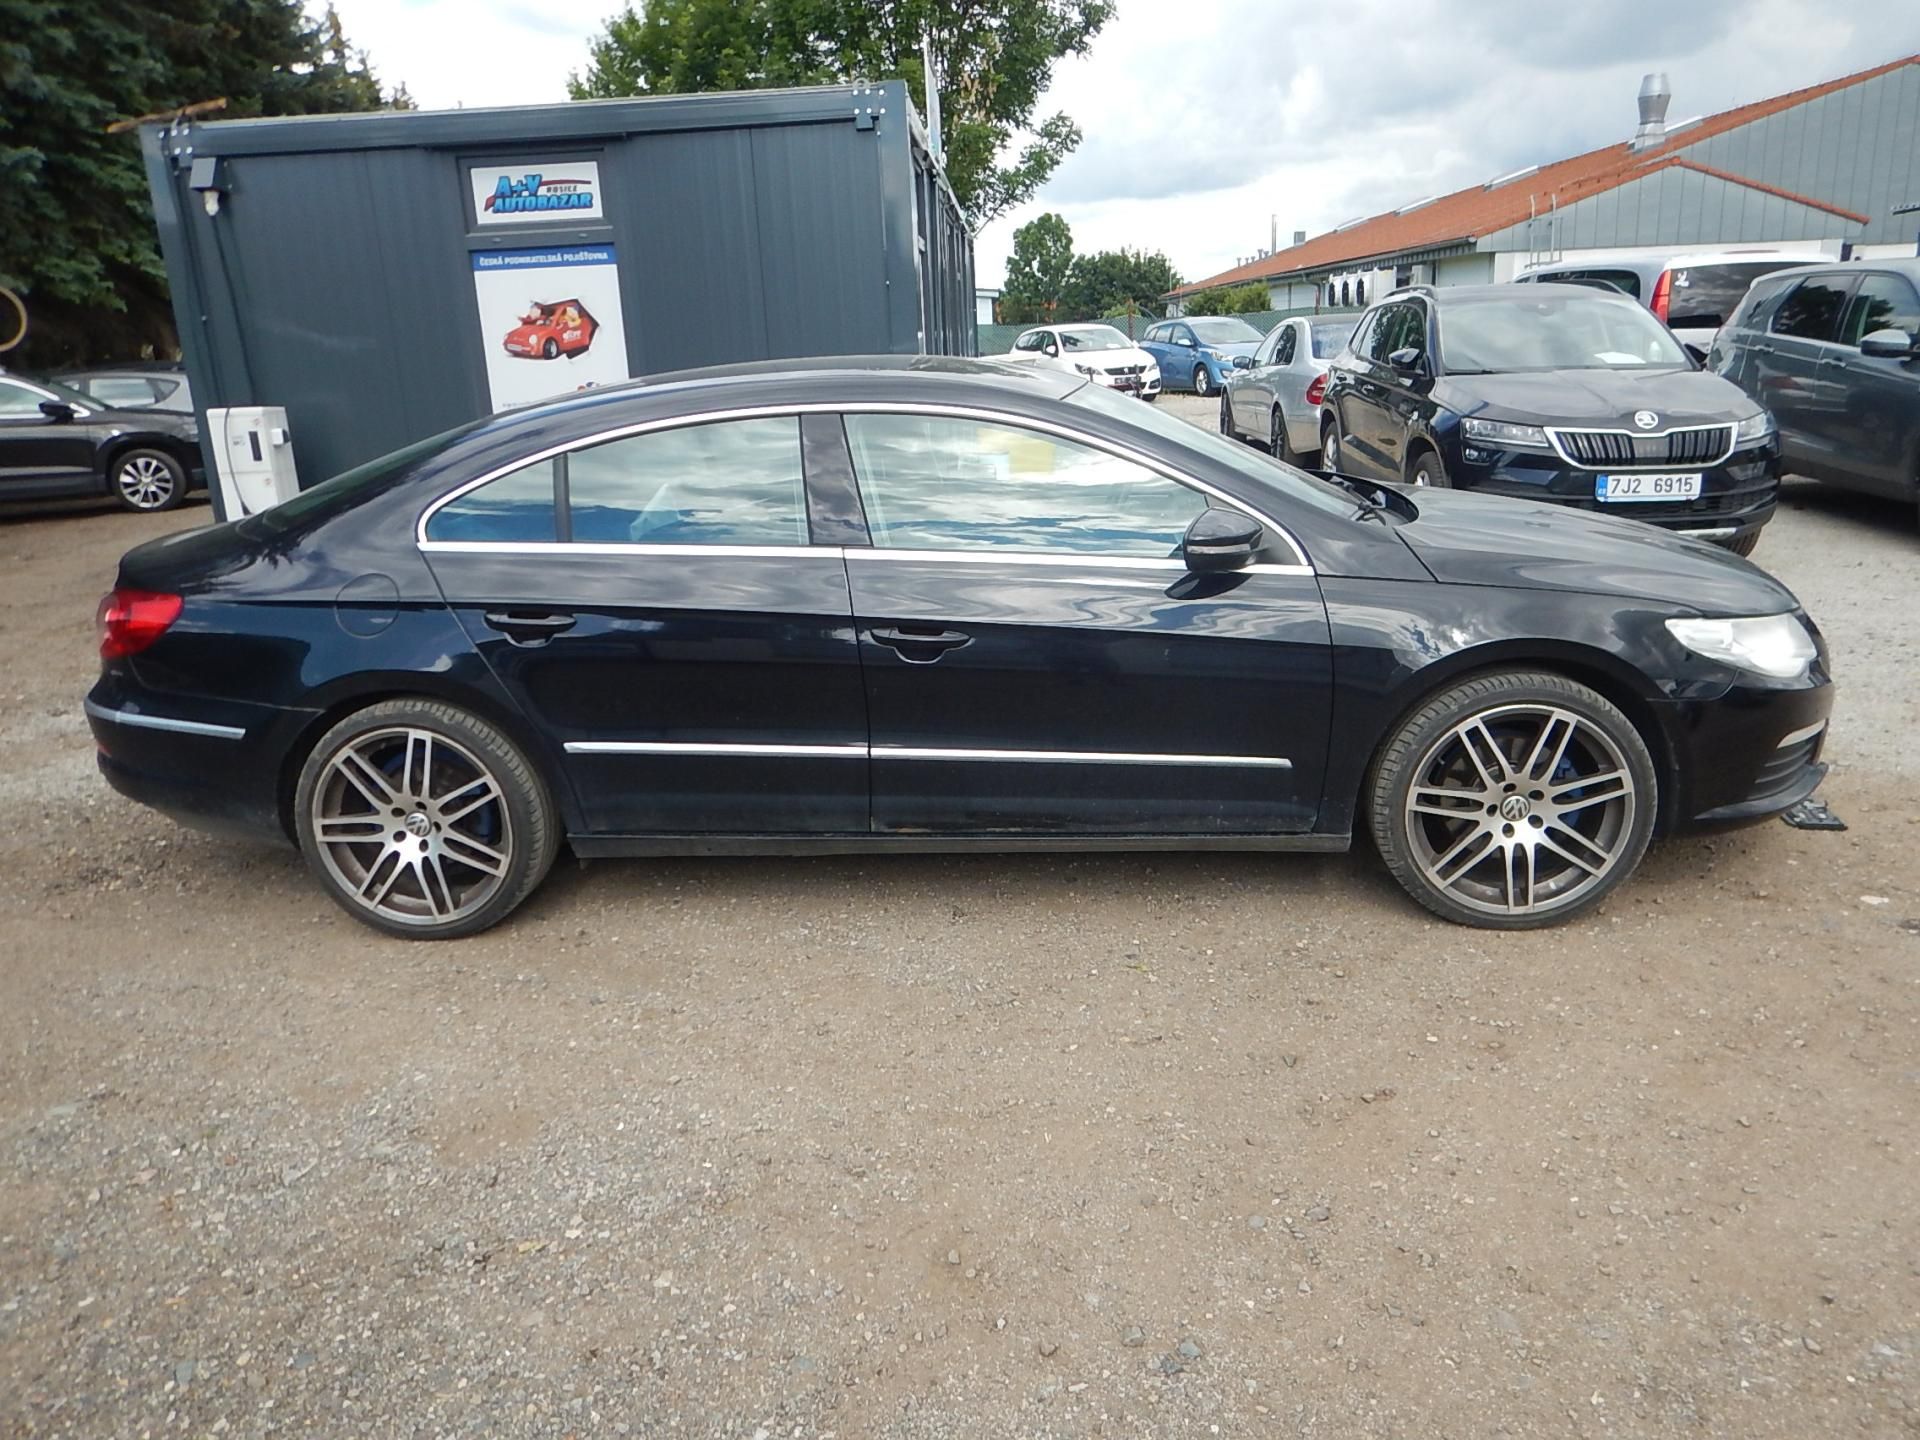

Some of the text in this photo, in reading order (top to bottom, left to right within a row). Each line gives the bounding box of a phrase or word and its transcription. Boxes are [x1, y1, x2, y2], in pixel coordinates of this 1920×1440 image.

[495, 174, 542, 197] A+V
[492, 193, 593, 213] AUTOBAZAR
[1611, 477, 1693, 494] 7J2 6915
